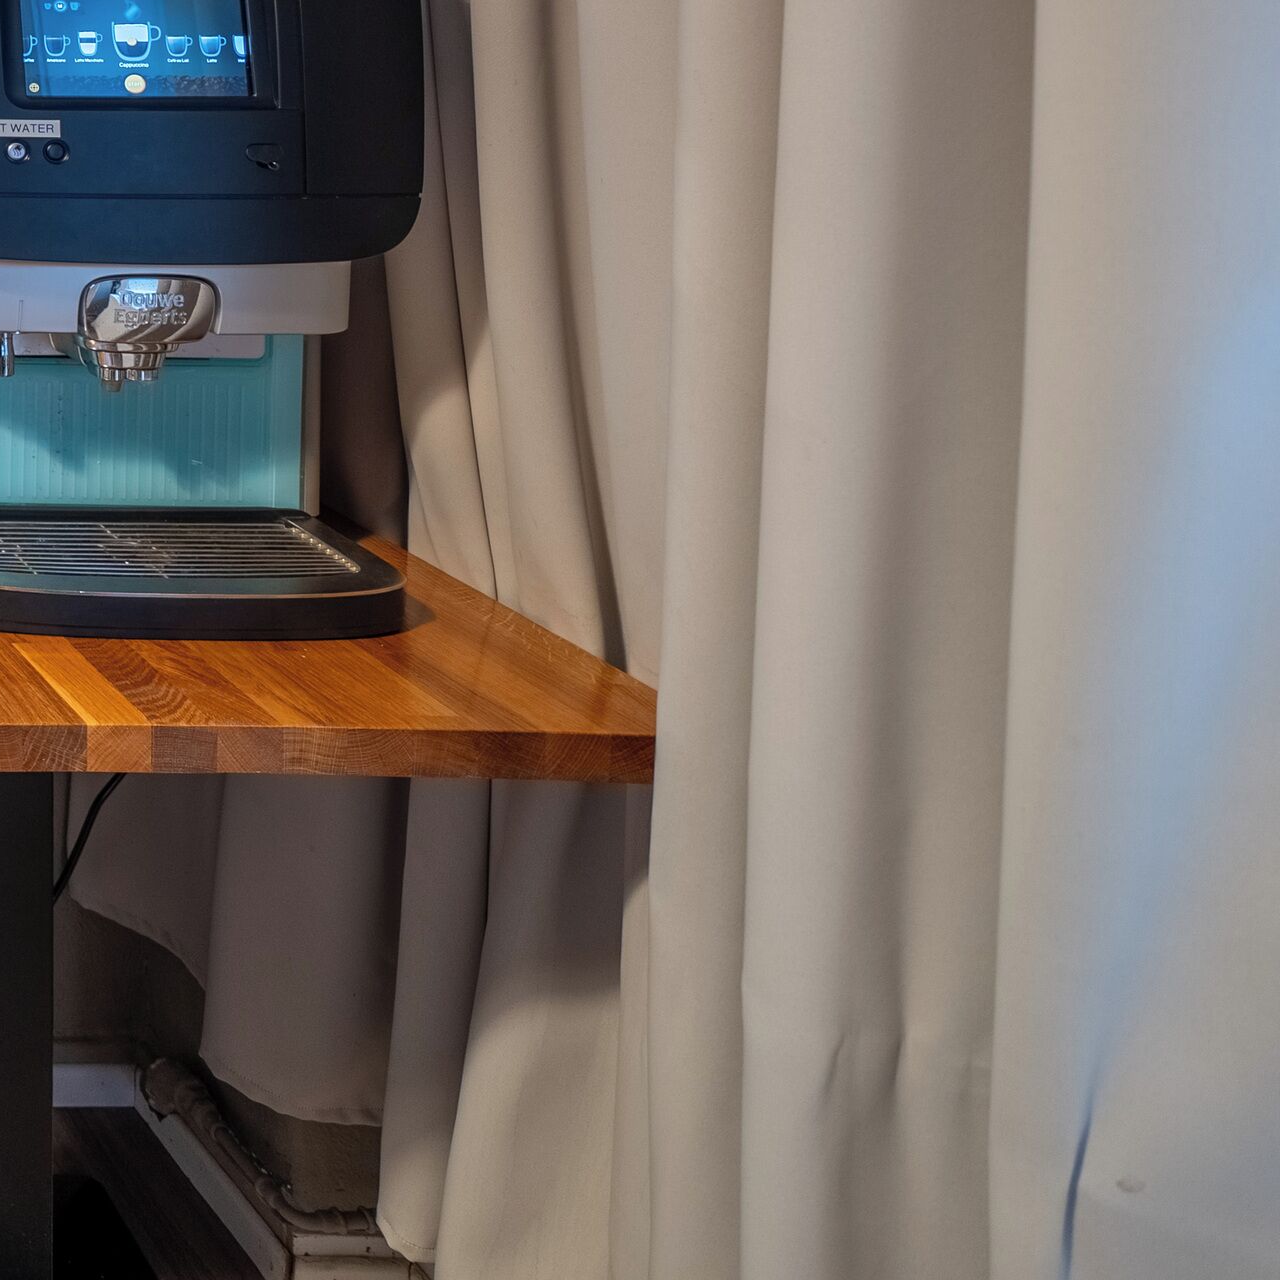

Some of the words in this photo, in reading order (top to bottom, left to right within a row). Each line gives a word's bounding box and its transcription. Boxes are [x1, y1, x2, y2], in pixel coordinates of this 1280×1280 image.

[10, 123, 55, 133] WATER
[119, 289, 185, 308] Douwe
[113, 308, 188, 329] Egberts
